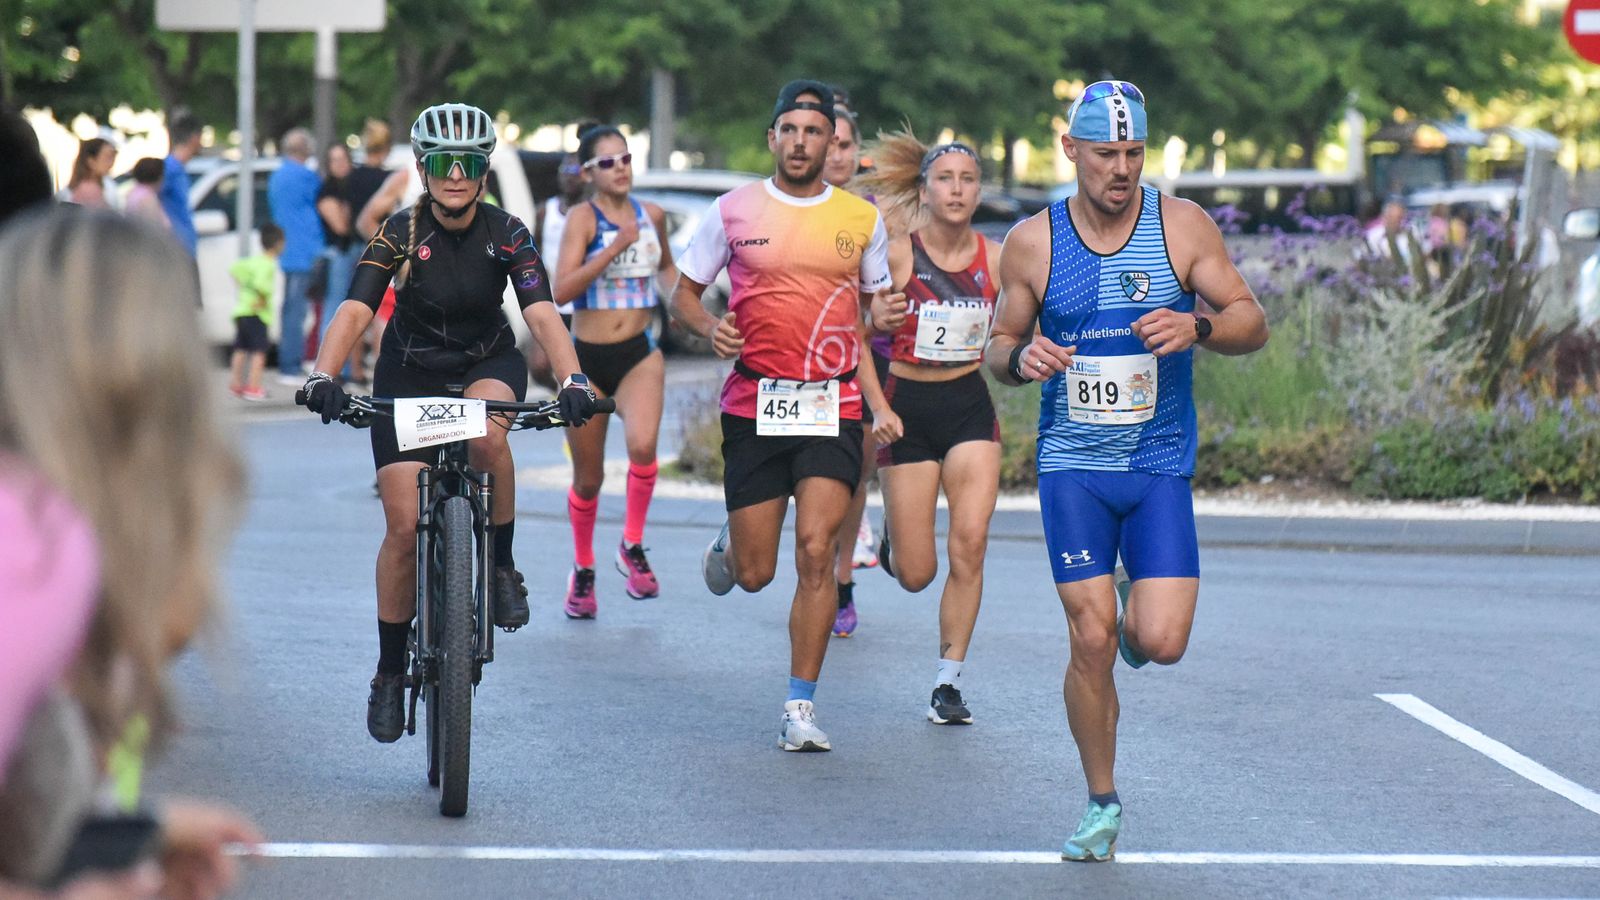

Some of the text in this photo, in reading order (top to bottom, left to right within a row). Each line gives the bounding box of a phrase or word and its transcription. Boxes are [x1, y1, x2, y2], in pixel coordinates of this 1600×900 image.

[934, 326, 946, 345] 2
[1061, 327, 1131, 342] Club Atletismo
[1078, 380, 1119, 405] 819
[416, 404, 467, 422] XXI
[763, 399, 800, 419] 454
